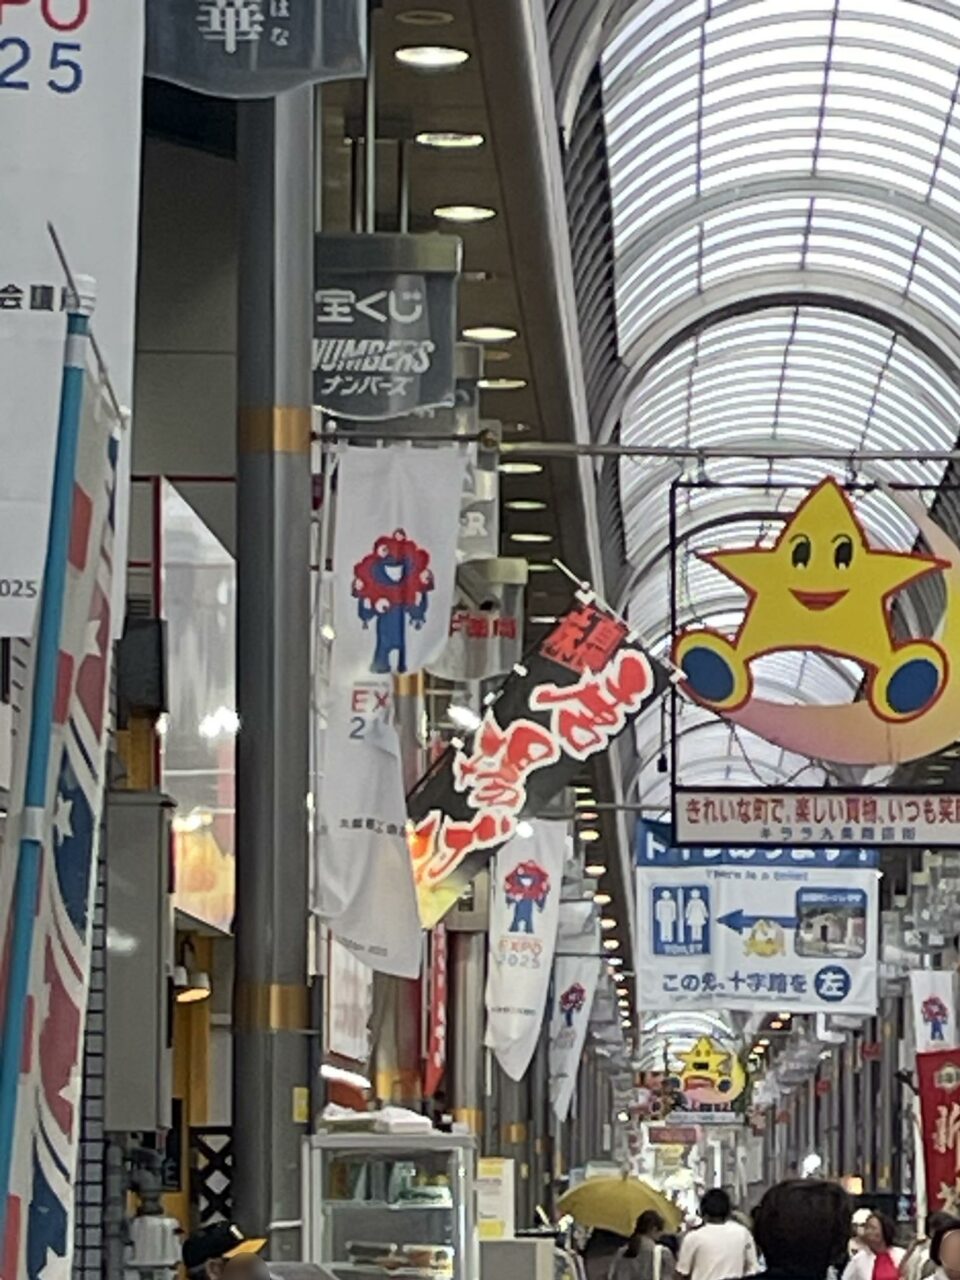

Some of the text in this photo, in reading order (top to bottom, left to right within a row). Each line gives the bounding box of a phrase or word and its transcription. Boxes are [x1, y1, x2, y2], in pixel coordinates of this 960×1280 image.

[315, 288, 422, 323] 宝くじ
[819, 972, 847, 997] 左
